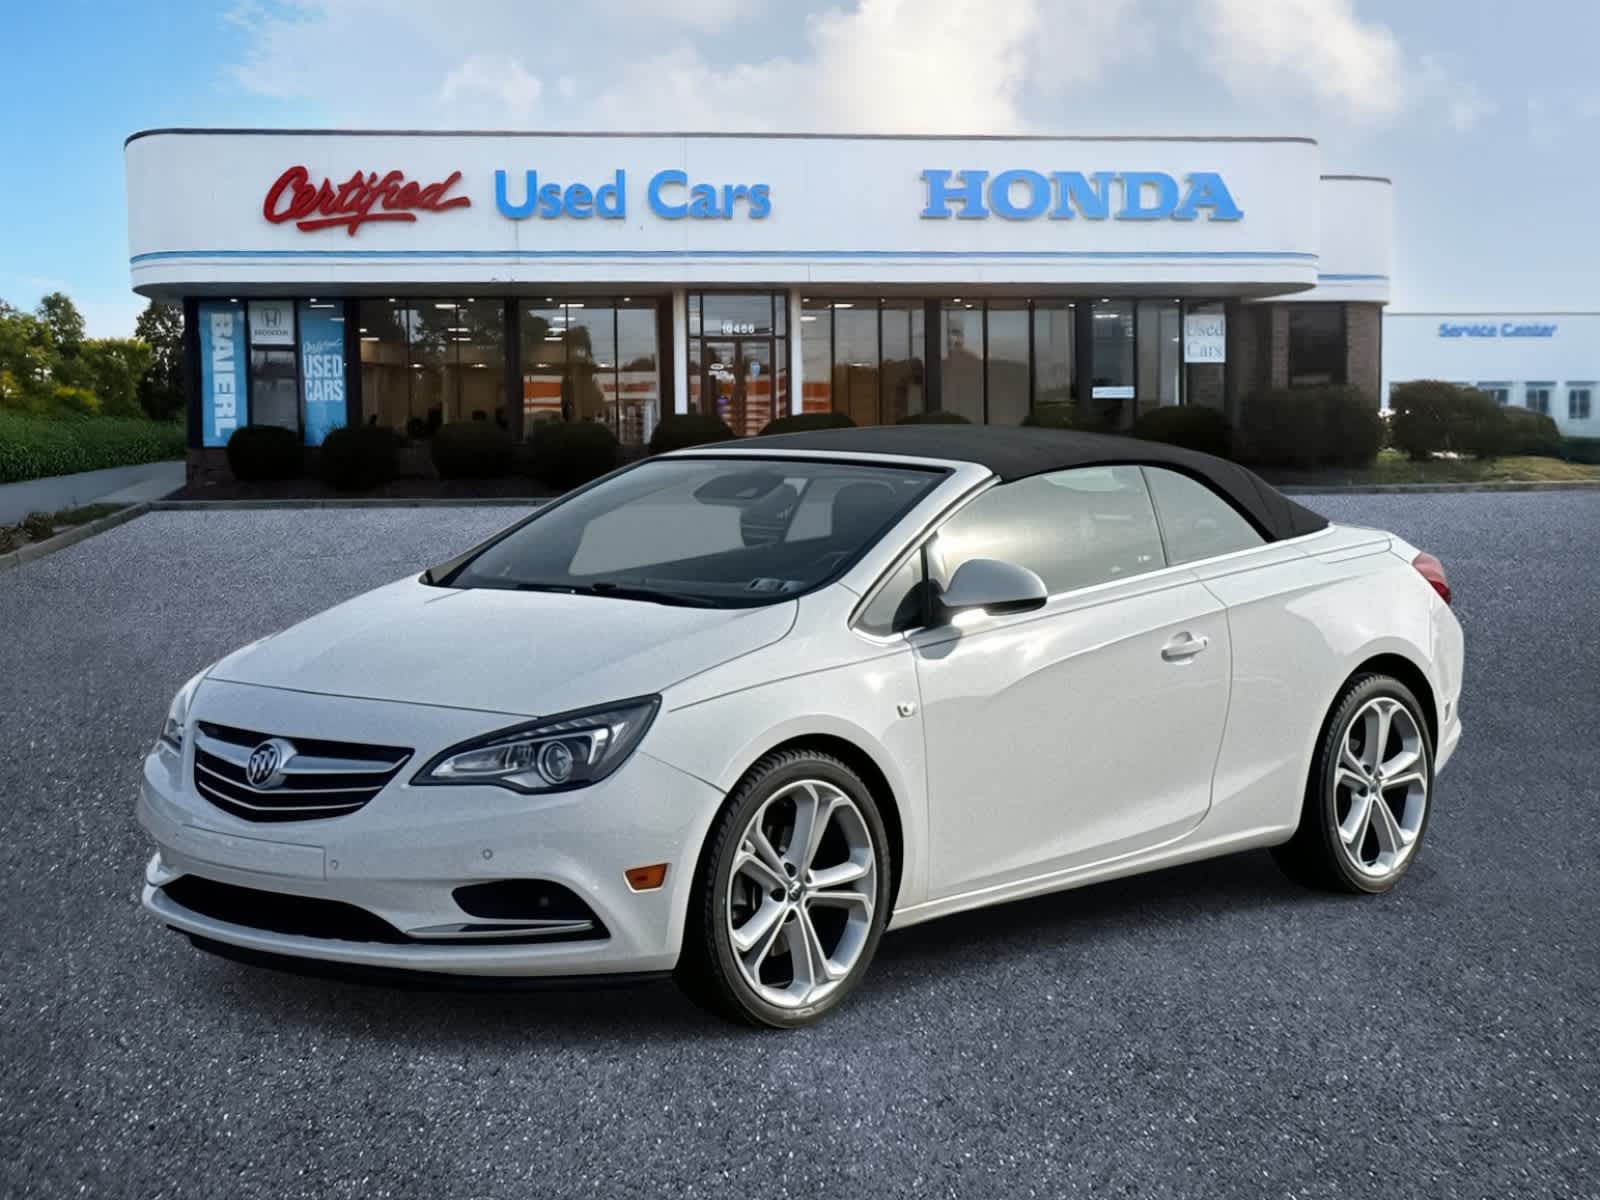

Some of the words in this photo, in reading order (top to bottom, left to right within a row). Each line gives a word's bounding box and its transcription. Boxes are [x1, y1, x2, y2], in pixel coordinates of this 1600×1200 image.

[263, 165, 470, 237] Certified
[494, 168, 627, 220] Used
[647, 168, 772, 220] Cars
[919, 168, 1244, 222] HONDA
[1186, 318, 1224, 337] Used
[1439, 323, 1497, 337] Service
[1501, 323, 1558, 337] Center
[1186, 340, 1223, 358] Cars
[210, 312, 237, 437] BAIERL
[303, 354, 344, 378] USED
[304, 379, 344, 401] CARS
